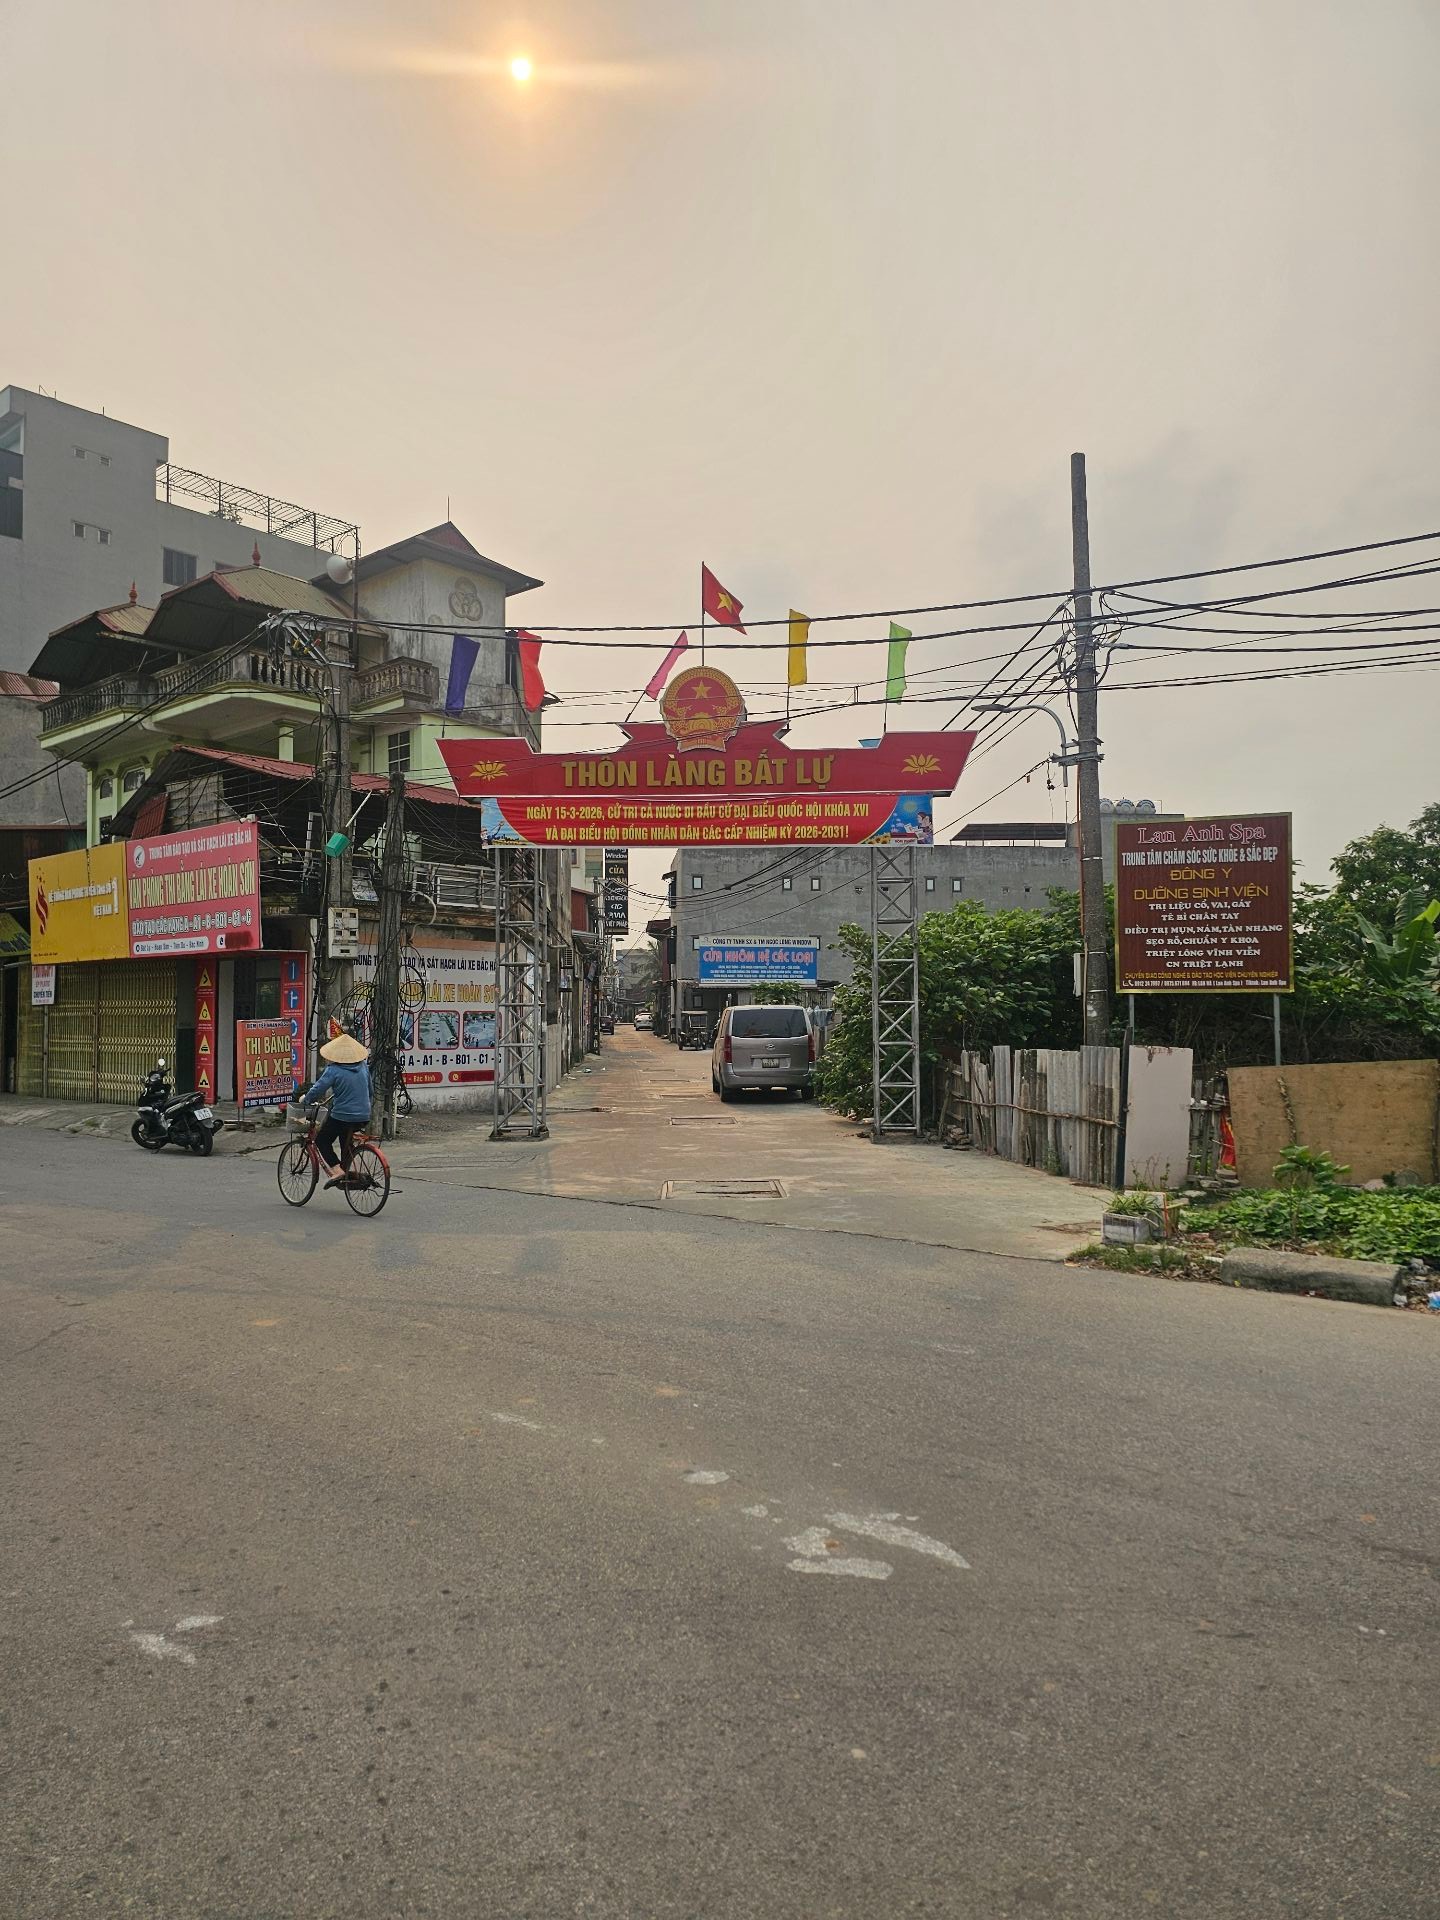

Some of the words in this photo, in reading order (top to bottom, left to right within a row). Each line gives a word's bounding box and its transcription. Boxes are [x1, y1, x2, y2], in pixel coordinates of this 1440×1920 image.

[561, 755, 637, 787] THÔN
[646, 753, 726, 787] LÀNG
[735, 749, 787, 785] BẤT
[797, 754, 834, 789] LỰ
[526, 804, 552, 819] NGÀY
[555, 806, 605, 820] 15-3-2026,
[608, 802, 622, 819] CỬ
[623, 806, 637, 819] TRI
[640, 802, 653, 819] CẢ
[656, 804, 681, 818] NƯỚC
[719, 802, 733, 818] CỬ
[734, 805, 749, 820] ĐẠI
[752, 800, 774, 818] BIỂU
[778, 800, 803, 817] QUỐC
[806, 803, 821, 819] HỘI
[825, 803, 850, 817] KHÓA
[853, 804, 868, 816] XVI
[227, 834, 234, 846] XE
[244, 827, 252, 843] HÀ
[546, 825, 558, 840] VÀ
[561, 827, 576, 842] ĐẠI
[580, 823, 600, 840] BIỂU
[604, 825, 619, 842] HỘI
[622, 824, 648, 840] ĐỒNG
[651, 825, 677, 839] NHÂN
[681, 825, 699, 839] DÂN
[703, 825, 721, 839] CÁC
[724, 823, 743, 839] CẤP
[746, 824, 777, 842] NHIỆM
[780, 824, 792, 838] KỲ
[795, 825, 849, 838] 2026-2031!
[1138, 828, 1176, 844] Lan
[1182, 825, 1224, 842] Anh
[1229, 823, 1266, 844] Spa
[1122, 852, 1146, 866] TRUNG
[1146, 849, 1162, 865] TÂM
[1163, 848, 1186, 864] CHĂM
[1186, 847, 1201, 863] SÓC
[1202, 846, 1217, 863] SỨC
[1218, 844, 1238, 863] KHỎE
[1239, 850, 1245, 862] &
[1247, 842, 1262, 861] SẮC
[1263, 847, 1278, 863] ĐẸP
[609, 865, 624, 874] CỬA
[1170, 867, 1215, 880] ĐÔNG
[1222, 868, 1232, 879] Y
[128, 874, 142, 909] VĂN
[142, 869, 164, 907] PHÒNG
[165, 874, 176, 904] THI
[177, 860, 195, 904] BẰNG
[196, 862, 207, 902] LÁI
[208, 867, 217, 899] XE
[218, 856, 238, 898] HOÀN
[240, 858, 255, 896] SƠN
[1134, 885, 1188, 900] DƯỠNG
[1192, 887, 1228, 898] SINH
[1148, 903, 1166, 912] TRỊ
[1169, 902, 1191, 911] LIỆU
[1194, 900, 1209, 910] CỔ,
[1232, 900, 1251, 908] GÁY
[1161, 913, 1174, 921] TÊ
[1177, 913, 1187, 921] BÌ
[1189, 912, 1218, 920] CHÂN
[1151, 927, 1168, 935] TRỊ
[1146, 938, 1164, 947] SẸO
[703, 947, 722, 963] CỬA
[725, 948, 755, 963] NHÔM
[758, 948, 770, 966] HỆ
[772, 948, 790, 963] CÁC
[791, 951, 814, 966] LOẠI
[1146, 948, 1175, 958] TRIỆT
[1178, 948, 1204, 957] LÔNG
[1207, 947, 1232, 956] VĨNH
[1236, 946, 1261, 956] VIỄN
[427, 955, 438, 969] SÁT
[440, 959, 456, 971] HẠCH
[457, 957, 467, 970] LÁI
[468, 959, 476, 971] XE
[477, 956, 488, 971] BẮC
[1183, 959, 1212, 968] TRIỆT
[1215, 960, 1243, 968] LẠNH
[427, 980, 441, 1002] LÁI
[444, 983, 456, 1002] XE
[457, 981, 481, 1003] HOÀN
[246, 1037, 260, 1055] THI
[264, 1030, 290, 1054] BẰNG
[246, 1057, 268, 1078] LÁI
[273, 1058, 290, 1075] XE
[408, 1055, 414, 1066] A
[423, 1055, 433, 1066] A1
[442, 1054, 447, 1065] B
[456, 1054, 470, 1065] B01
[479, 1054, 488, 1064] C1
